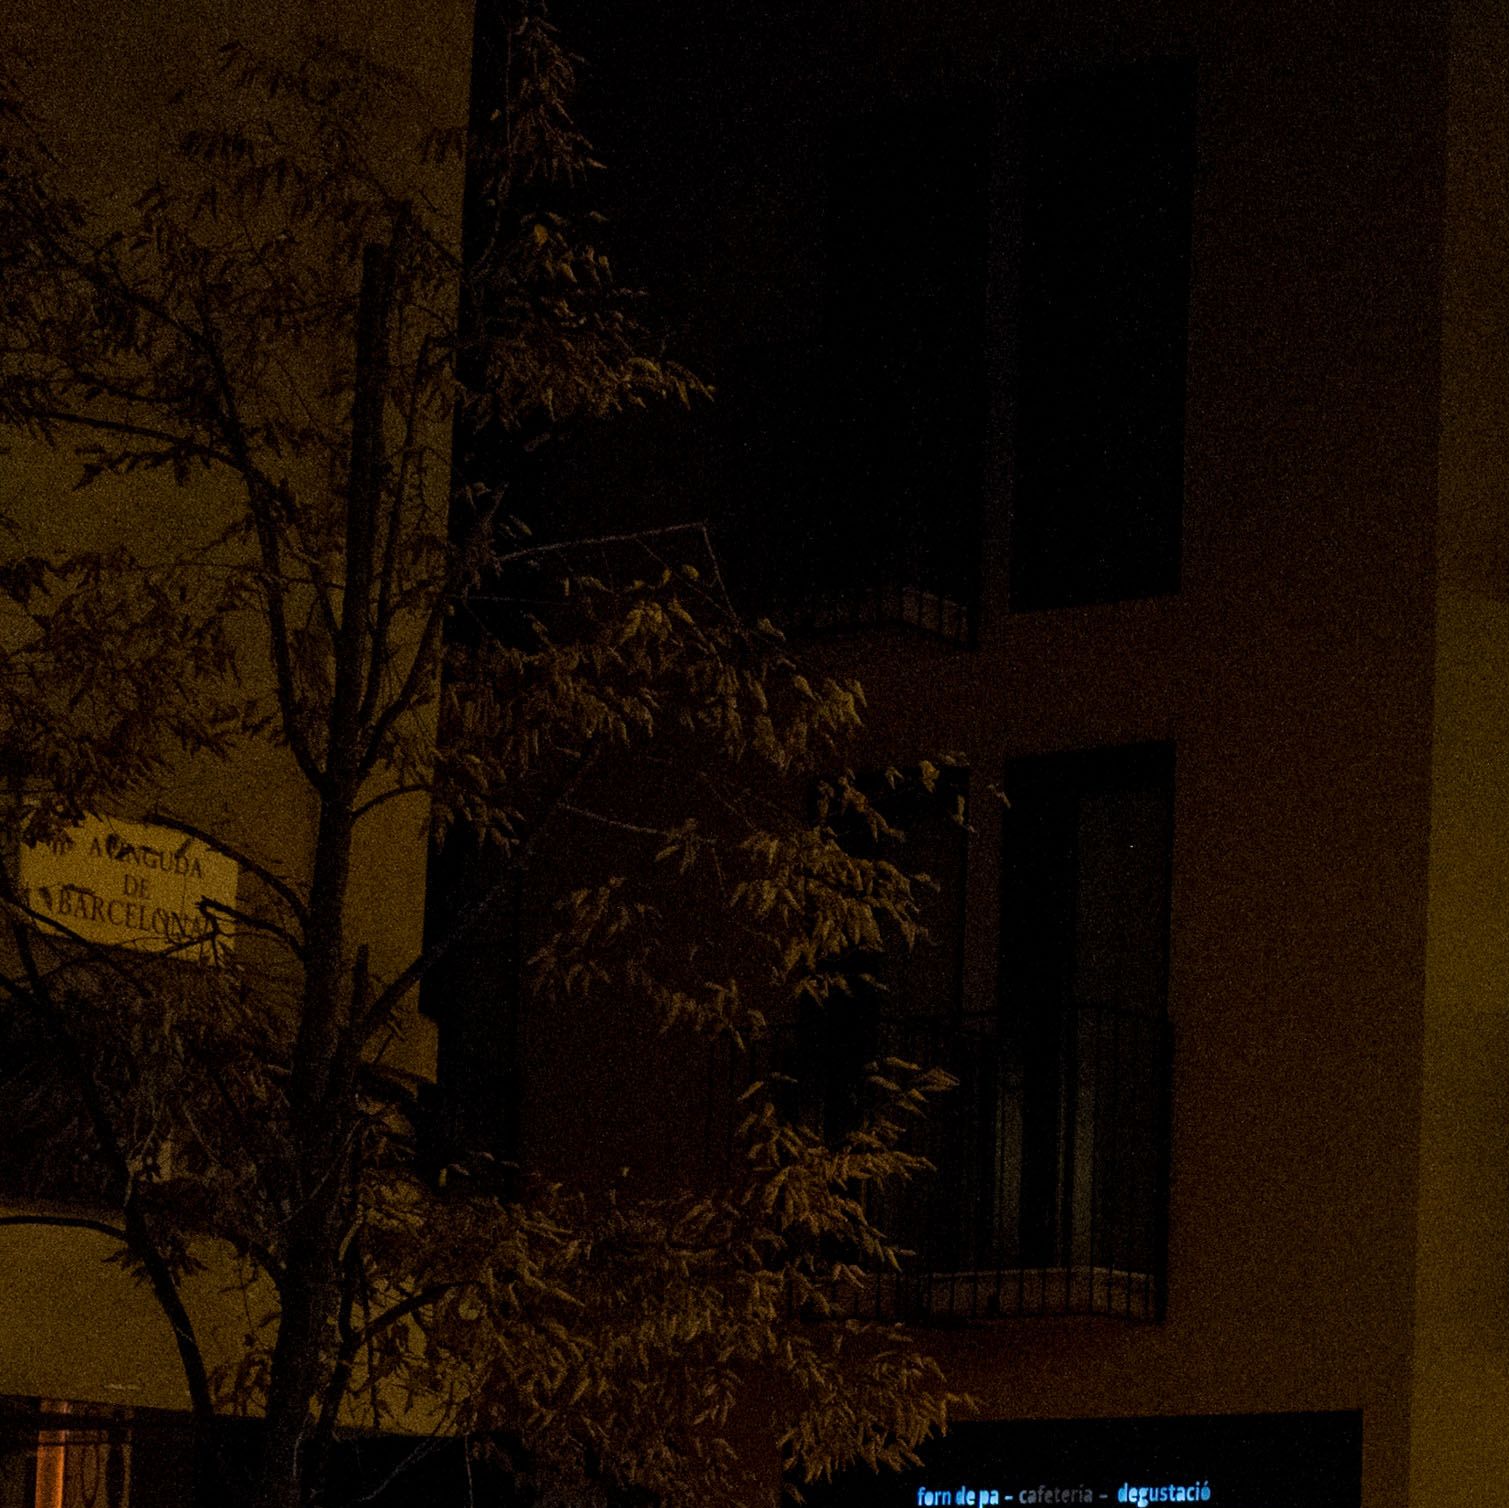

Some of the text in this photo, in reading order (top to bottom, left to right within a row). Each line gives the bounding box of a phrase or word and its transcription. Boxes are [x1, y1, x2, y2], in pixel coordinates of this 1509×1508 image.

[124, 873, 150, 900] DE
[917, 1486, 951, 1506] forn
[955, 1485, 976, 1505] de
[978, 1487, 999, 1508] pa
[1117, 1481, 1211, 1508] degustació
